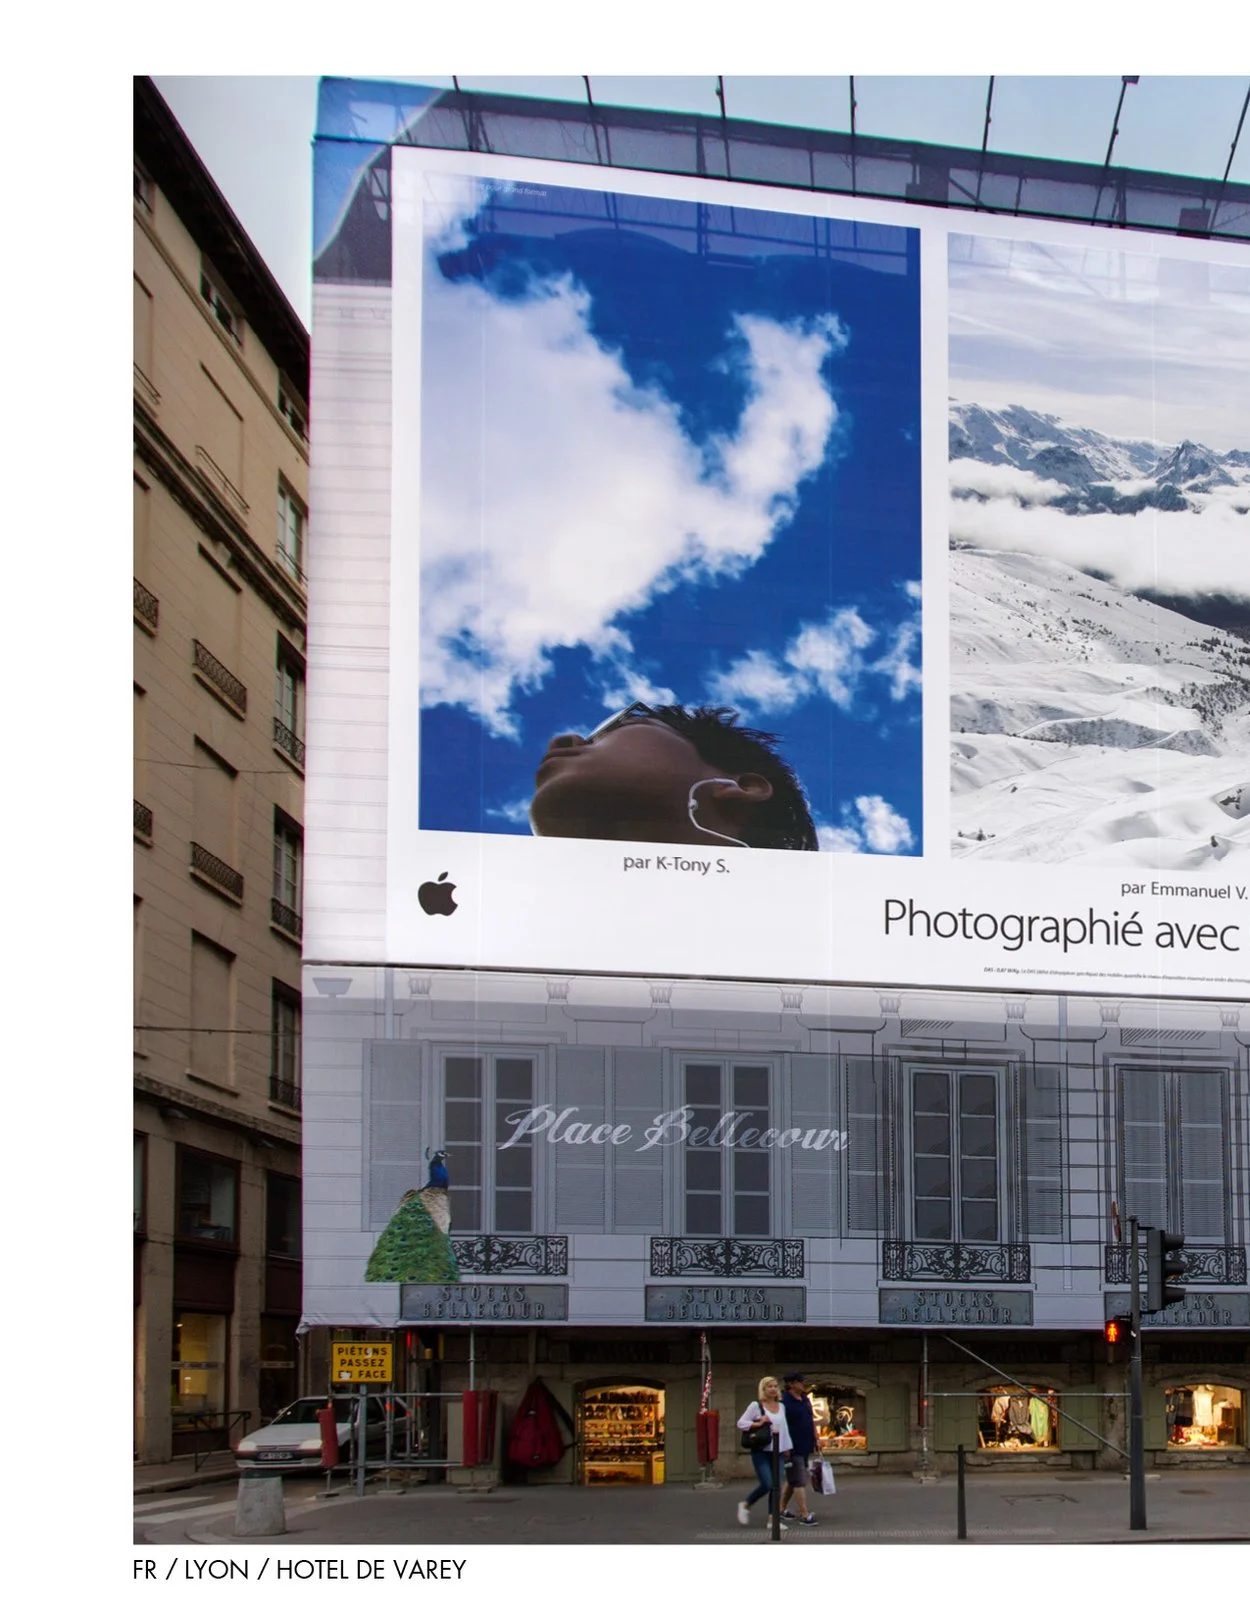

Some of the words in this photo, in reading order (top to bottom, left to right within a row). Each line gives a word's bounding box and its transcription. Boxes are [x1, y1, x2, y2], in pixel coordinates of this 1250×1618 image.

[623, 856, 651, 872] par
[656, 856, 711, 876] K-Tony
[716, 858, 730, 873] S.
[1121, 883, 1146, 897] par
[1151, 881, 1231, 899] Emmanuel
[1236, 886, 1248, 900] V.
[885, 898, 1144, 954] Photographié
[1156, 921, 1240, 952] avec
[498, 1103, 633, 1151] Place
[635, 1104, 853, 1152] Bellecour
[442, 1286, 526, 1302] STOCKS
[685, 1288, 766, 1303] STOCKS
[916, 1290, 994, 1307] STOCKS
[421, 1302, 546, 1320] BELLECOUR
[664, 1304, 785, 1321] BELLECOUR
[898, 1307, 1013, 1324] BELLECOUR
[340, 1358, 385, 1367] PASSEZ
[358, 1370, 387, 1379] FACE
